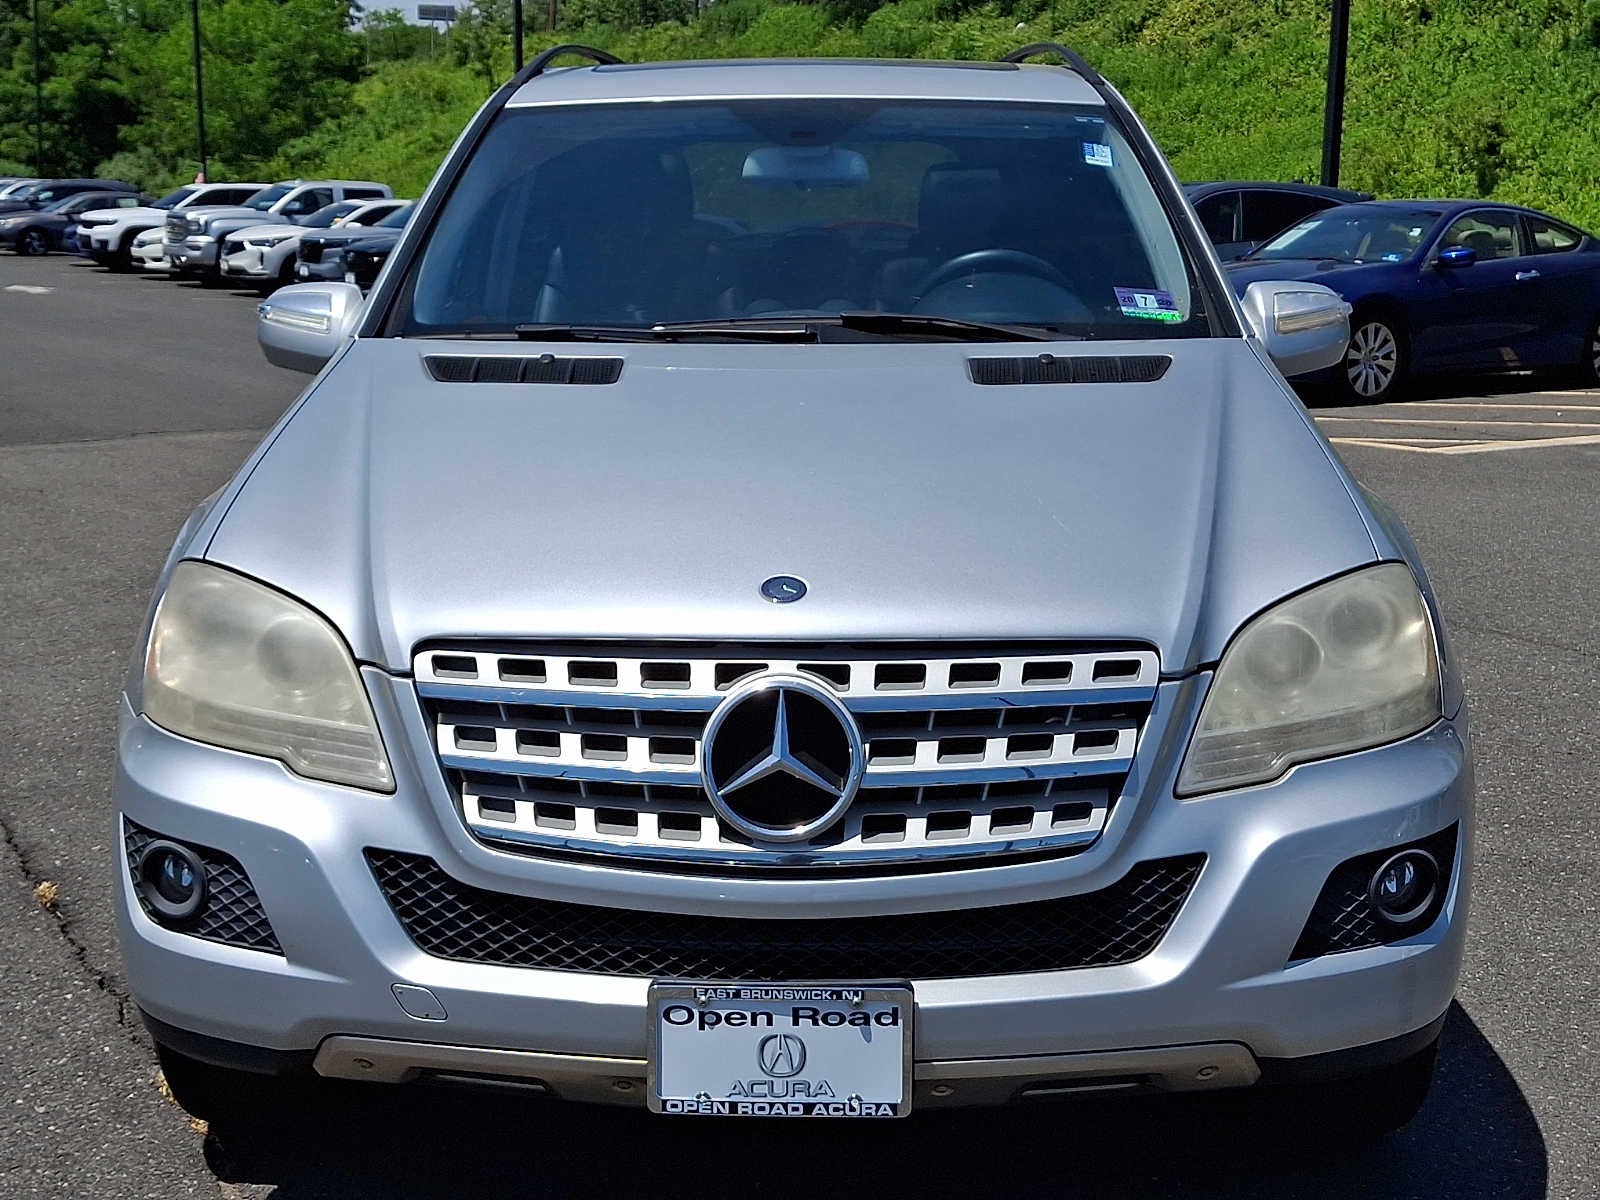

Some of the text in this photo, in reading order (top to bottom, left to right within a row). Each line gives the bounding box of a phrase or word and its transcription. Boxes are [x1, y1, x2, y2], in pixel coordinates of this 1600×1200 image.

[1140, 296, 1148, 306] 7
[695, 988, 735, 1000] EAST
[662, 1004, 900, 1030] Open Road
[726, 1079, 835, 1098] ACURA
[666, 1100, 894, 1116] OPEN ROAD ACURA
